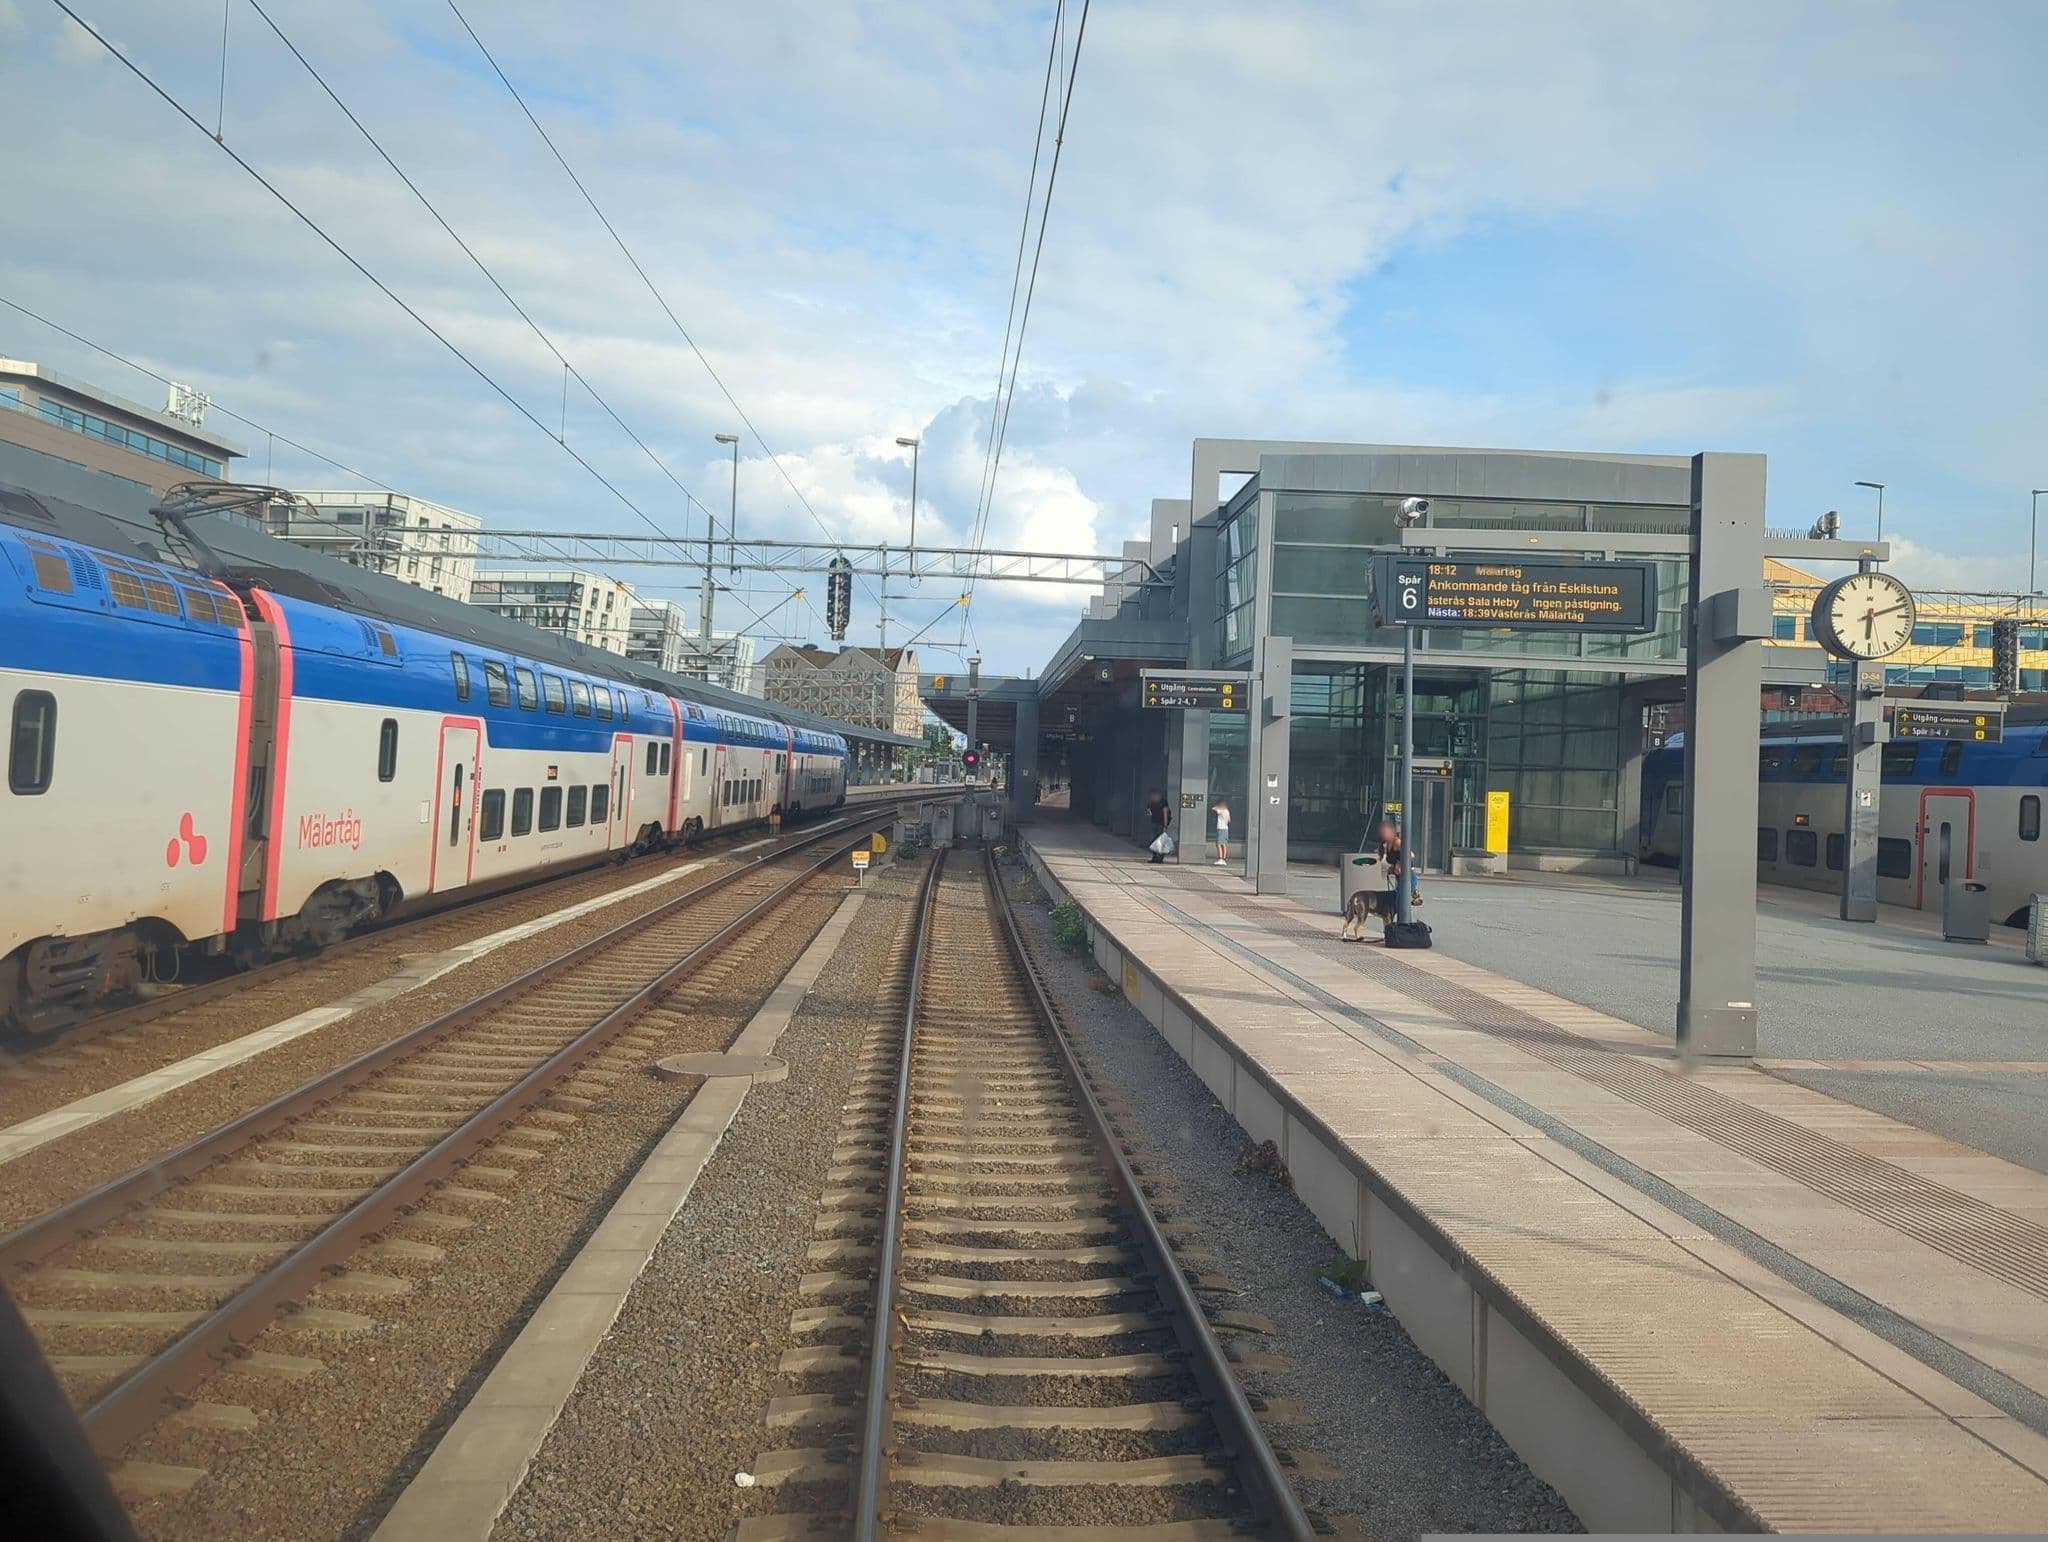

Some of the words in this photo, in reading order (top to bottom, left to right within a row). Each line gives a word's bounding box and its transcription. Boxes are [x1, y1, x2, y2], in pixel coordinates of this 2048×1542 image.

[1429, 564, 1457, 576] 18:12
[1398, 575, 1422, 586] Spår
[1428, 580, 1508, 593] Ankommande
[1511, 581, 1529, 595] tåg
[1533, 581, 1557, 594] från
[1559, 582, 1618, 595] Eskilstuna
[1402, 587, 1417, 609] 6
[1468, 596, 1490, 606] Sala
[1493, 597, 1520, 609] Heby
[1532, 598, 1562, 610] Ingen
[1564, 598, 1622, 613] påstigning.
[1428, 607, 1461, 617] Nästa:
[1539, 610, 1585, 622] Mälartåg
[1101, 668, 1108, 678] 6
[1160, 683, 1186, 693] Utgång
[1160, 697, 1176, 706] Spår
[1789, 695, 1796, 705] 5
[1912, 713, 1938, 724] Utgång
[1912, 727, 1928, 737] Spår
[298, 808, 361, 851] Mälartåg
